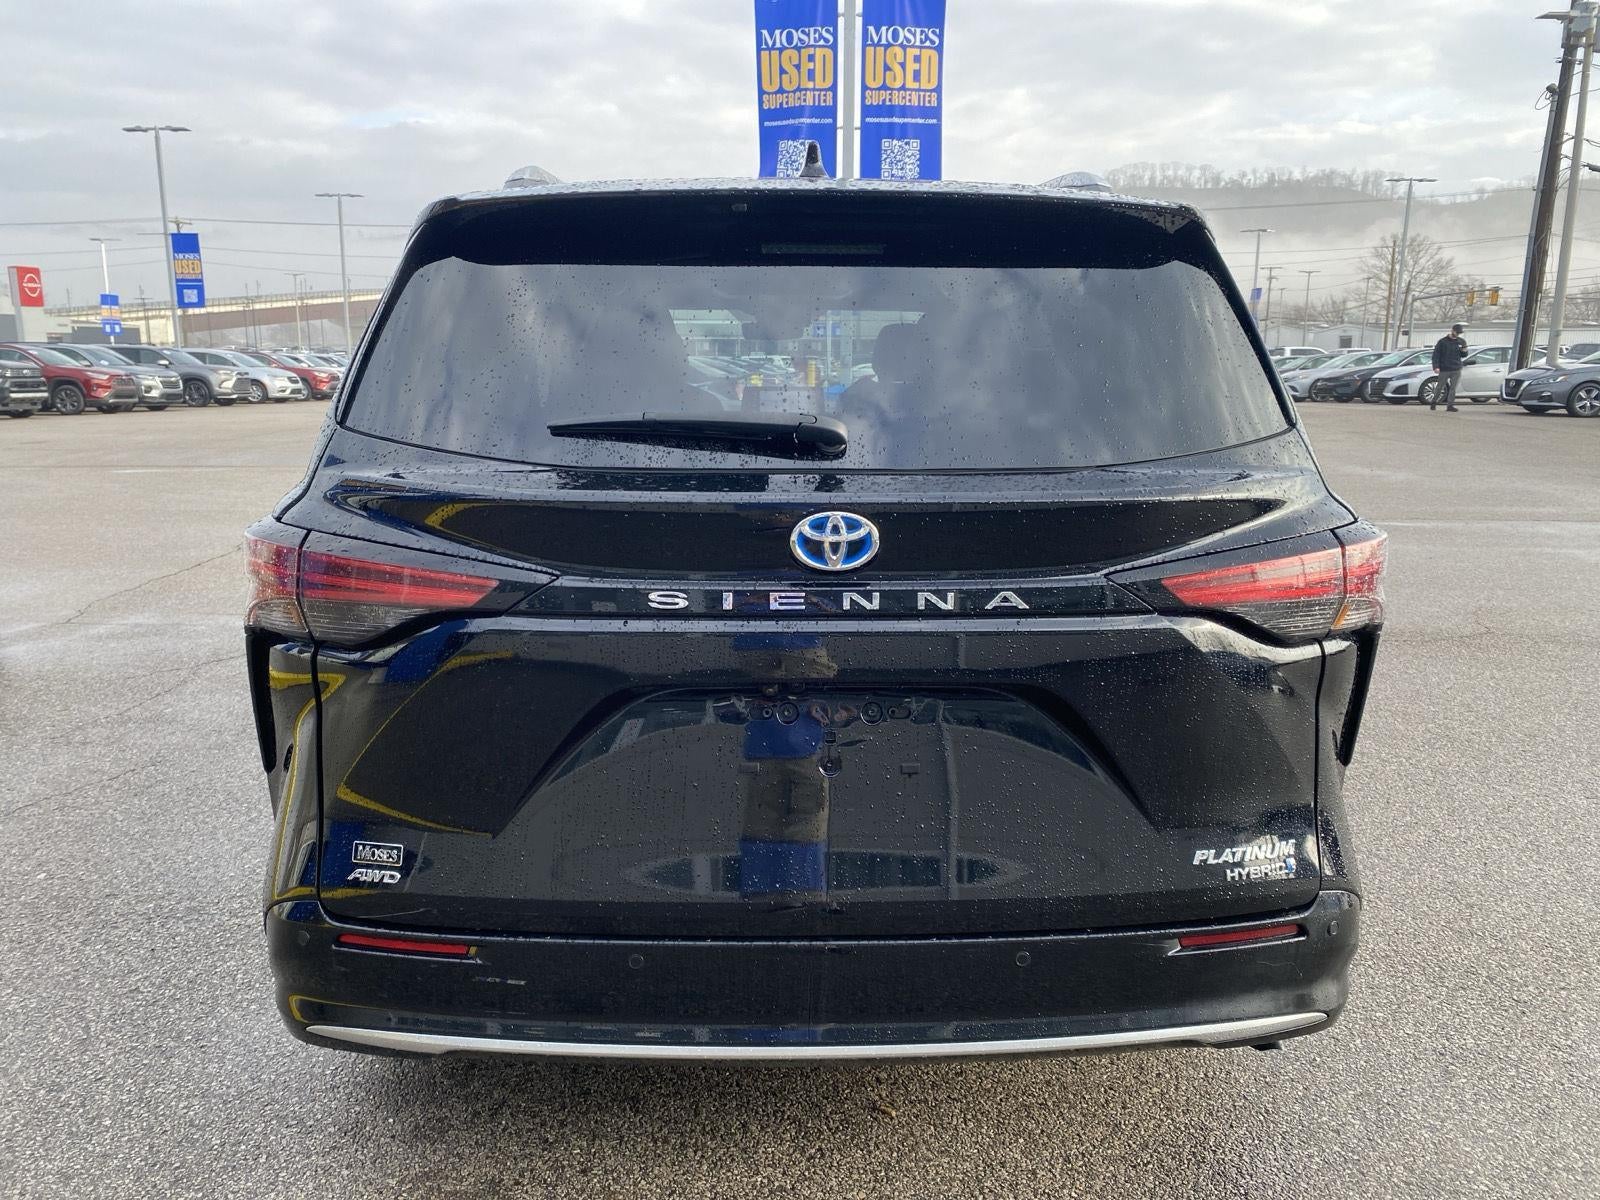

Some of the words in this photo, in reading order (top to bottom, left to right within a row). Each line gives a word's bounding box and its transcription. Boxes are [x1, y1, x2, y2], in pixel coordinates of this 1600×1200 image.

[760, 26, 834, 48] MOSES
[866, 25, 940, 47] MOSES
[761, 47, 834, 92] USED
[865, 46, 939, 89] USED
[763, 91, 833, 109] SUPERCENTER
[865, 90, 938, 107] SUPERCENTER
[175, 260, 202, 274] USED
[647, 591, 1030, 611] SIENNA
[356, 844, 398, 863] MOSES
[1192, 839, 1296, 866] PLATINUM
[347, 868, 402, 884] AWD
[1226, 862, 1286, 882] HYBRID
